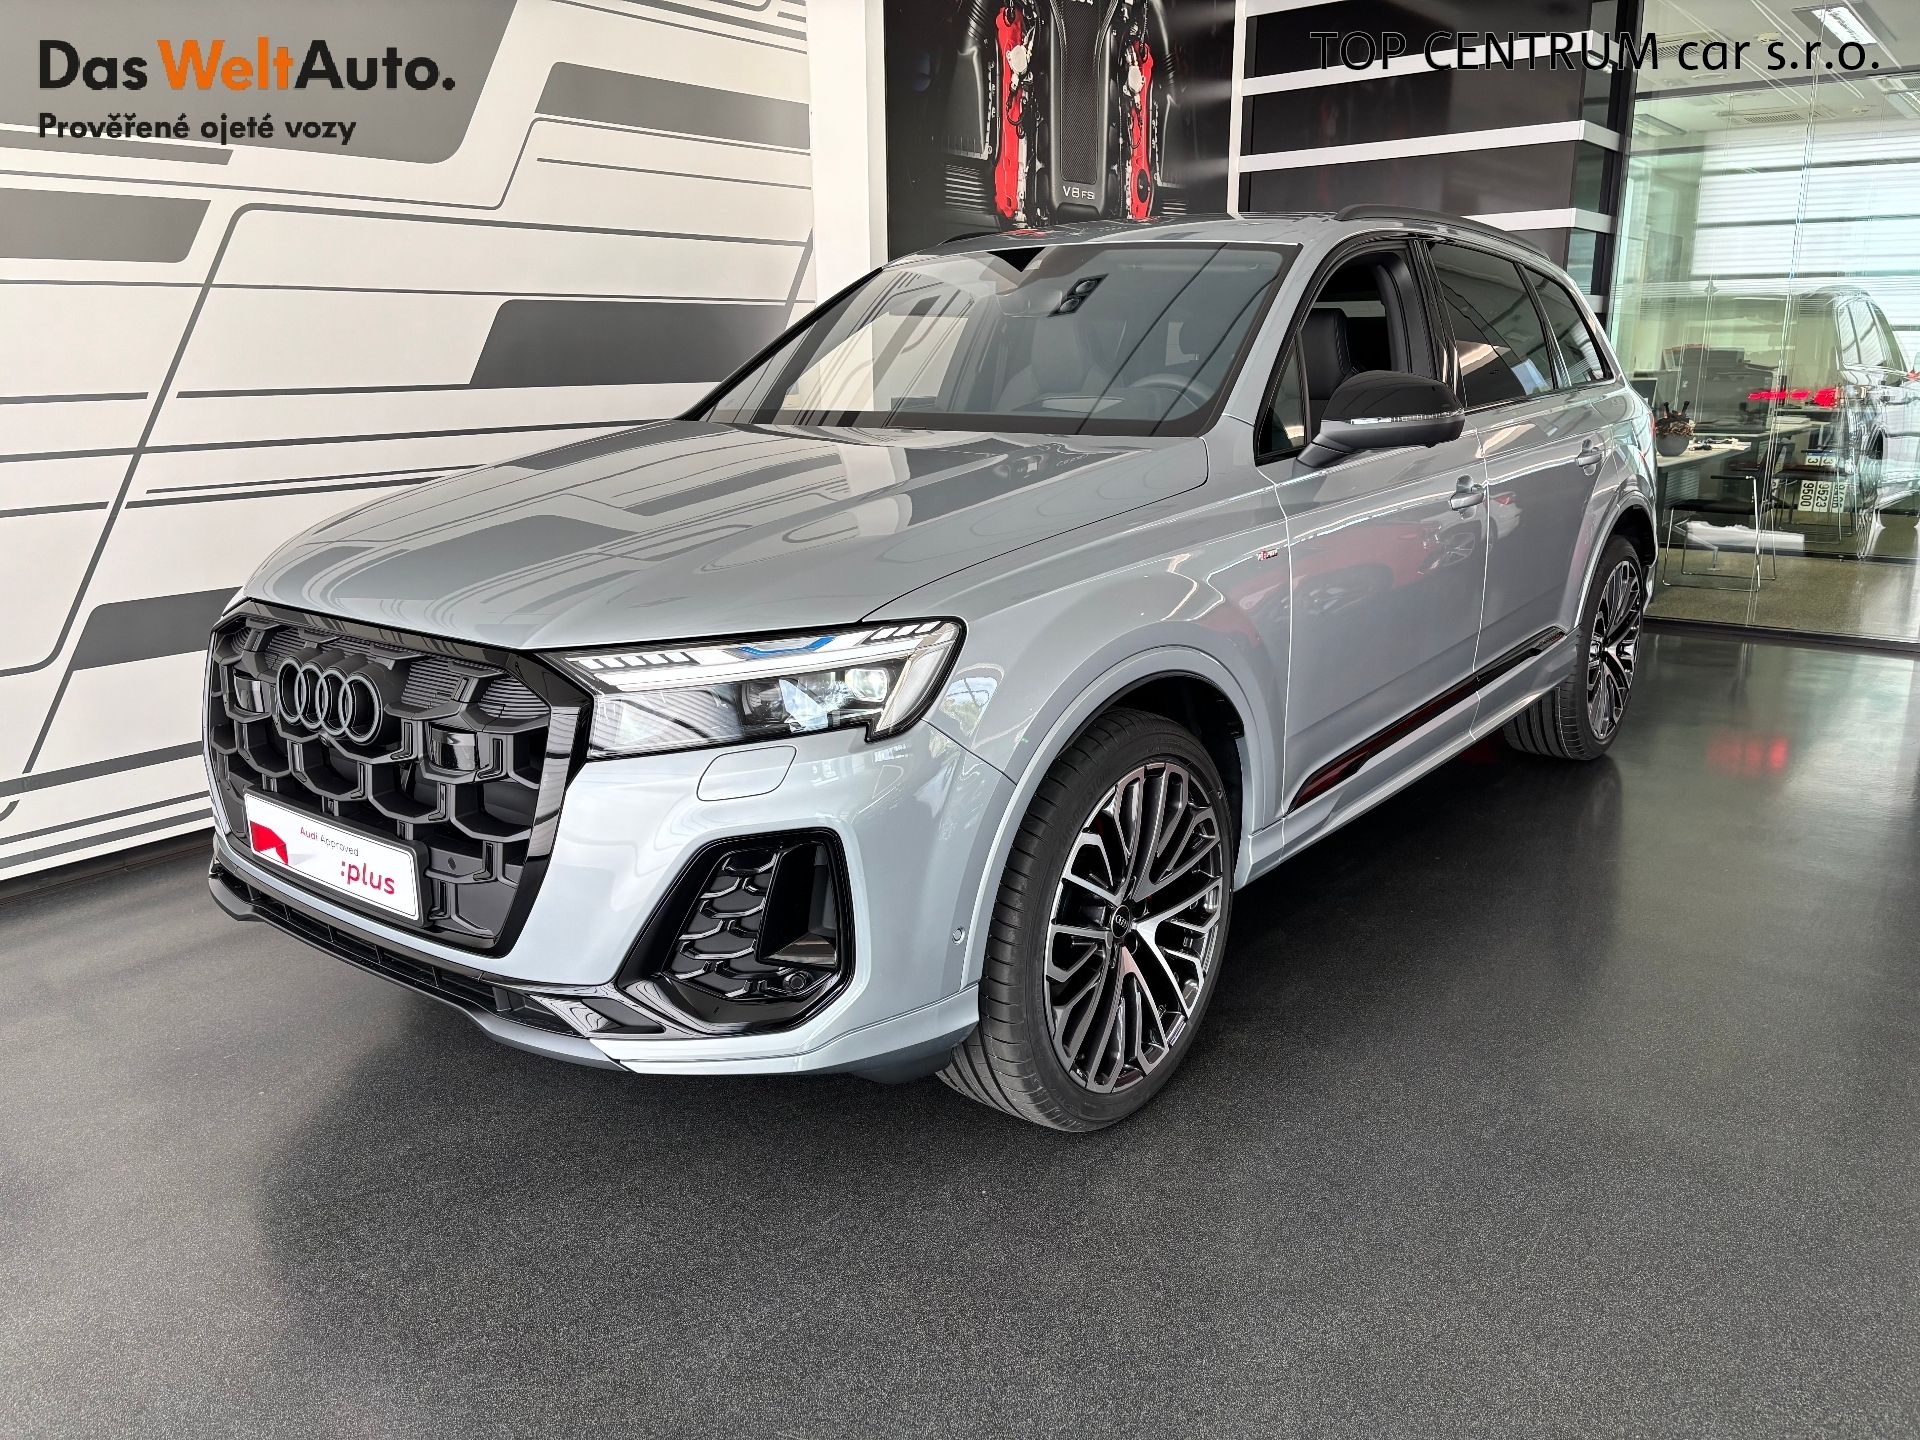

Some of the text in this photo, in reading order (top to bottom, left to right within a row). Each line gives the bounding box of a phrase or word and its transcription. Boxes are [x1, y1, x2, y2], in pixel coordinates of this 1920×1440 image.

[1800, 482, 1815, 507] 9500
[1815, 483, 1830, 508] 9523
[300, 826, 359, 857] Audi Approved
[341, 860, 395, 895] :plus
